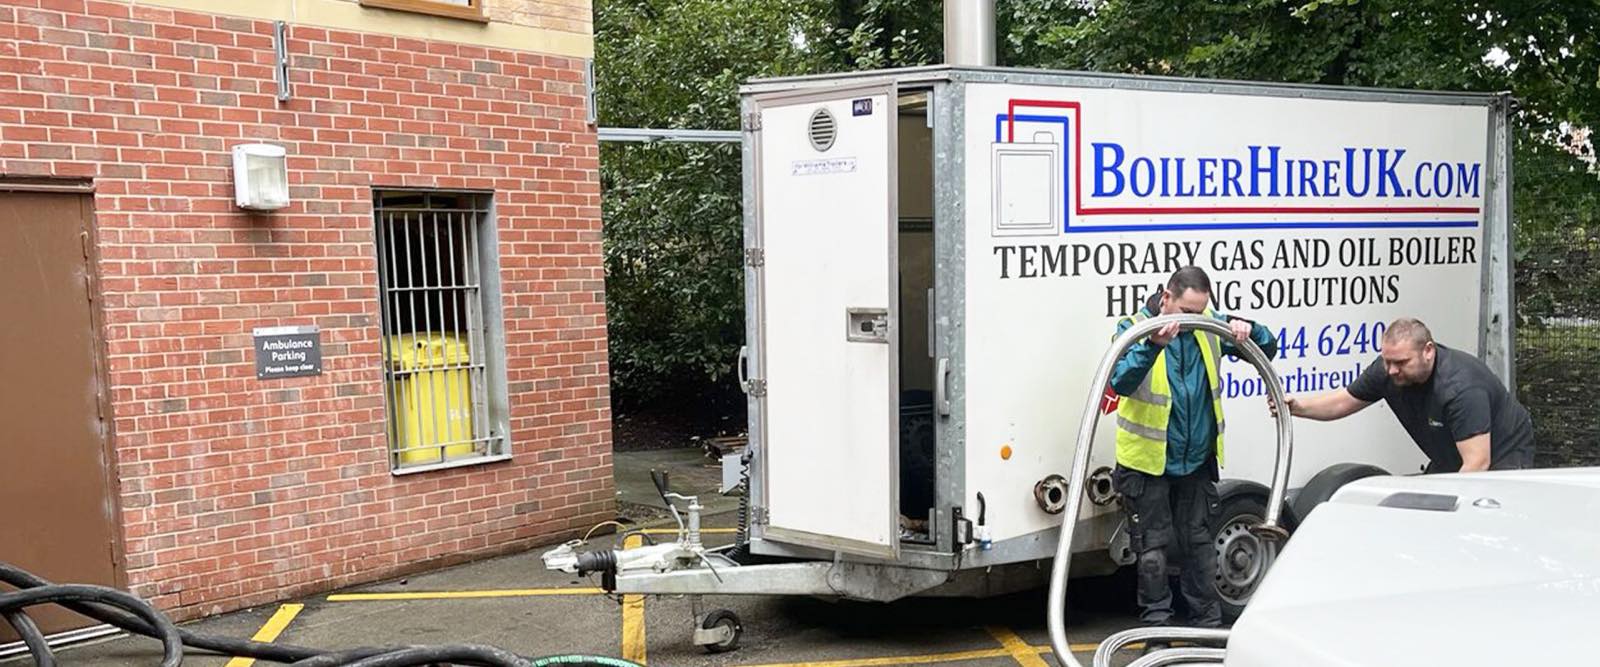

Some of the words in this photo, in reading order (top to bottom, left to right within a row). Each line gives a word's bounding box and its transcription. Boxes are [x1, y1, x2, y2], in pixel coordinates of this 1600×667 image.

[993, 241, 1202, 279] TEMPORARY
[1210, 239, 1265, 272] GAS
[1271, 238, 1330, 270] AND
[1338, 236, 1382, 268] OIL
[1388, 235, 1477, 266] BOILER
[1250, 274, 1400, 310] SOLUTIONS
[263, 339, 313, 351] Ambulance
[271, 351, 306, 362] Parking
